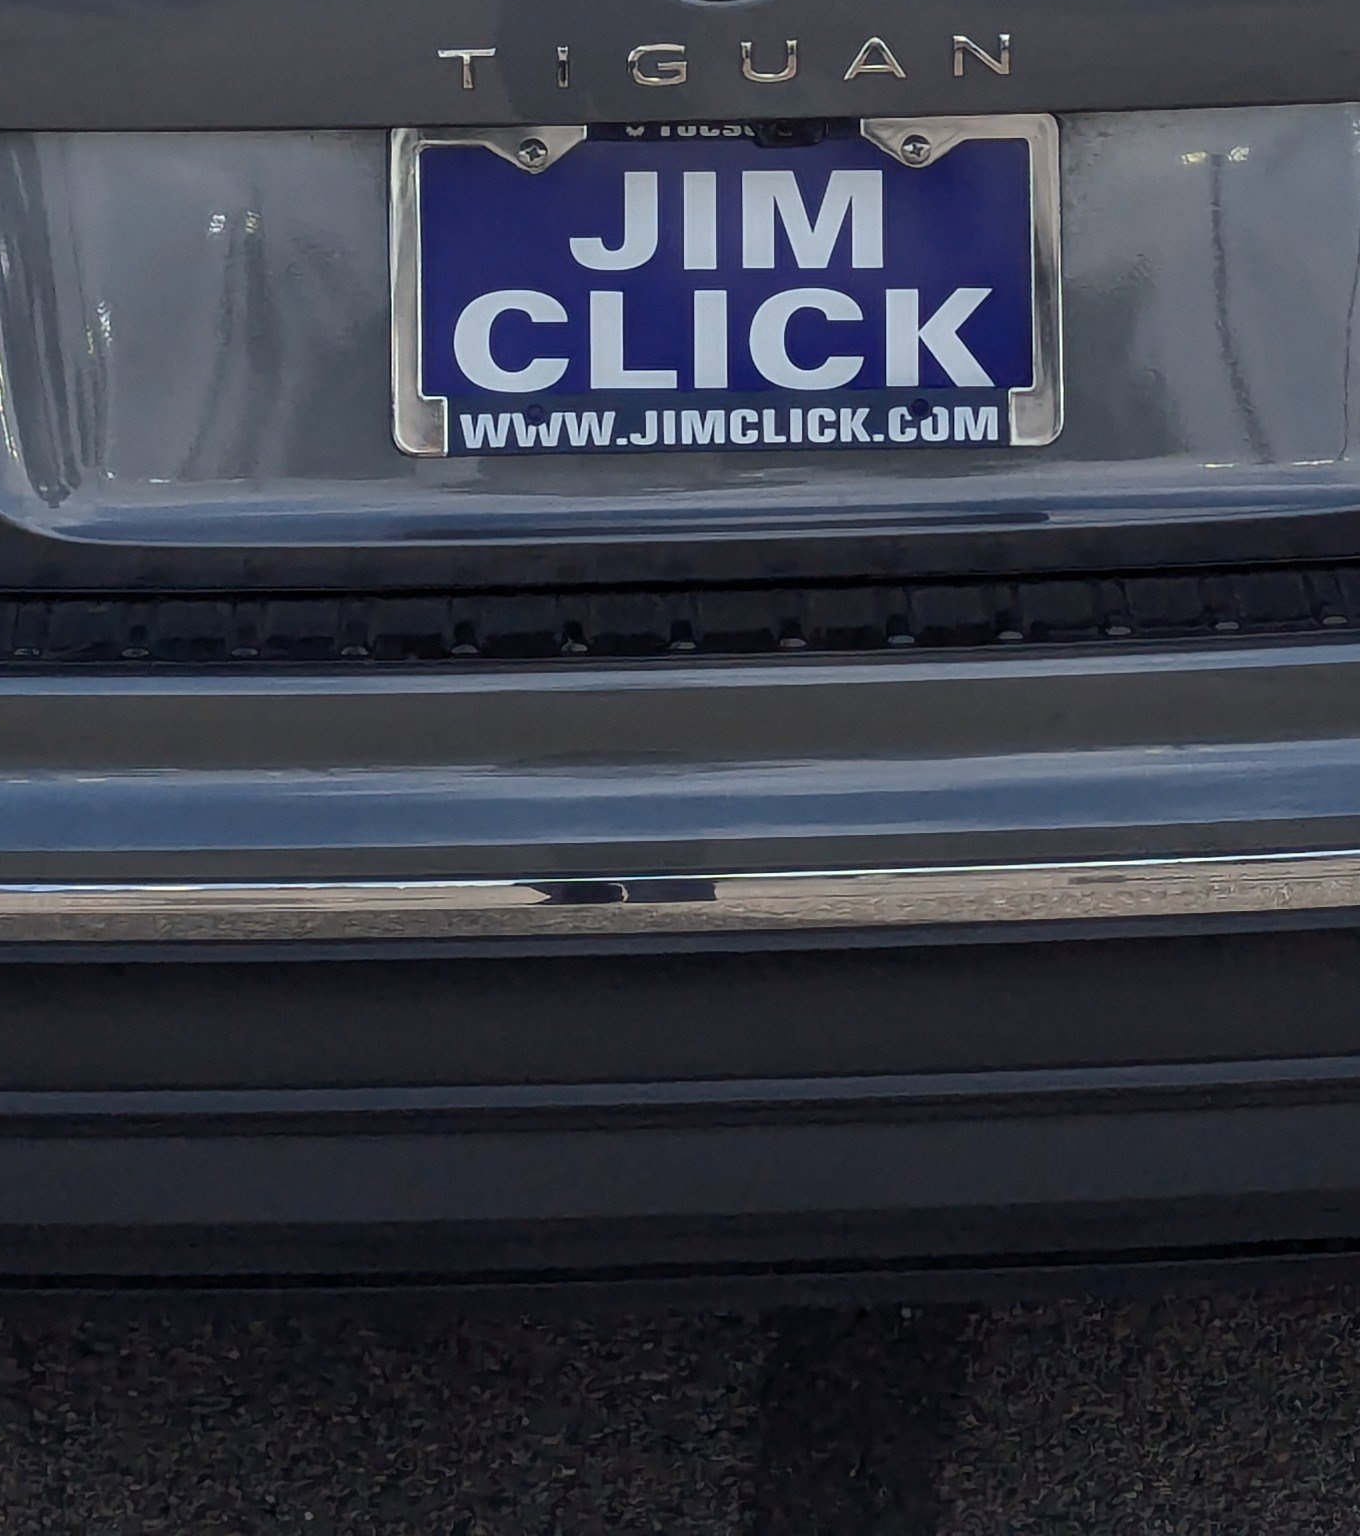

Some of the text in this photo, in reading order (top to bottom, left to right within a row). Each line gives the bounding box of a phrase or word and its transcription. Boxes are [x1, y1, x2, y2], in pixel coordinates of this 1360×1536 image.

[437, 33, 1013, 90] TIGUAN
[568, 169, 884, 271] JIM
[452, 286, 995, 394] CLICK
[459, 405, 1000, 449] WWW.JIMCLICK.COM
